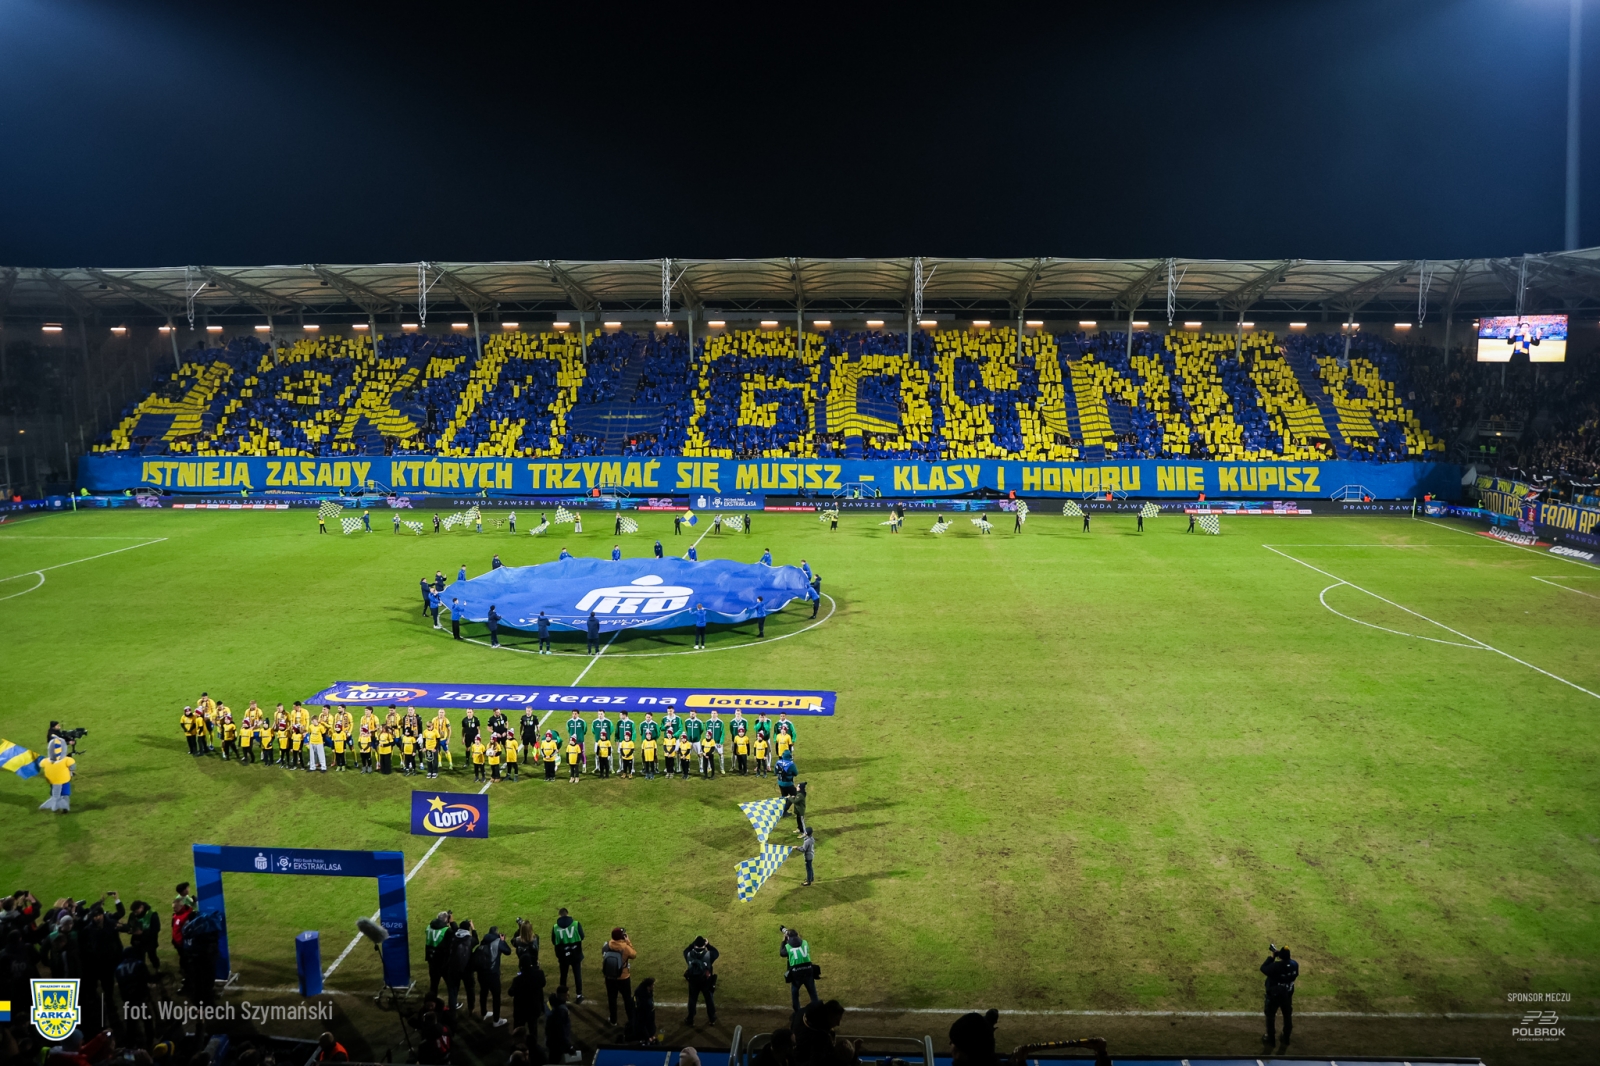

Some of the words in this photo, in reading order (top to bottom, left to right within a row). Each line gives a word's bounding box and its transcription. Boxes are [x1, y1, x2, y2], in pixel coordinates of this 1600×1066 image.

[142, 461, 254, 489] ISTNIEJĄ
[391, 459, 513, 489] KTÓRYCH
[528, 459, 661, 489] TRZYMAĆ
[676, 462, 721, 493] SIĘ
[735, 463, 842, 490] MUSISZ
[893, 464, 981, 490] KLASY
[997, 466, 1005, 490] I
[1022, 466, 1141, 492] HONORU
[1157, 466, 1205, 491] NIE
[1218, 467, 1321, 492] KUPISZ
[1540, 503, 1578, 531] FROM
[1488, 526, 1540, 546] SUPERBET
[1565, 533, 1598, 546] PRAWDA
[346, 690, 409, 700] LOTTO
[436, 691, 540, 705] Zagraj
[548, 693, 629, 704] teraz
[637, 695, 678, 704] na
[708, 696, 801, 708] lotto.pl
[434, 810, 469, 827] LOTTO
[293, 862, 342, 871] EKSTRAKLASA
[426, 927, 442, 942] TV
[556, 926, 575, 940] TV
[789, 945, 807, 960] TV
